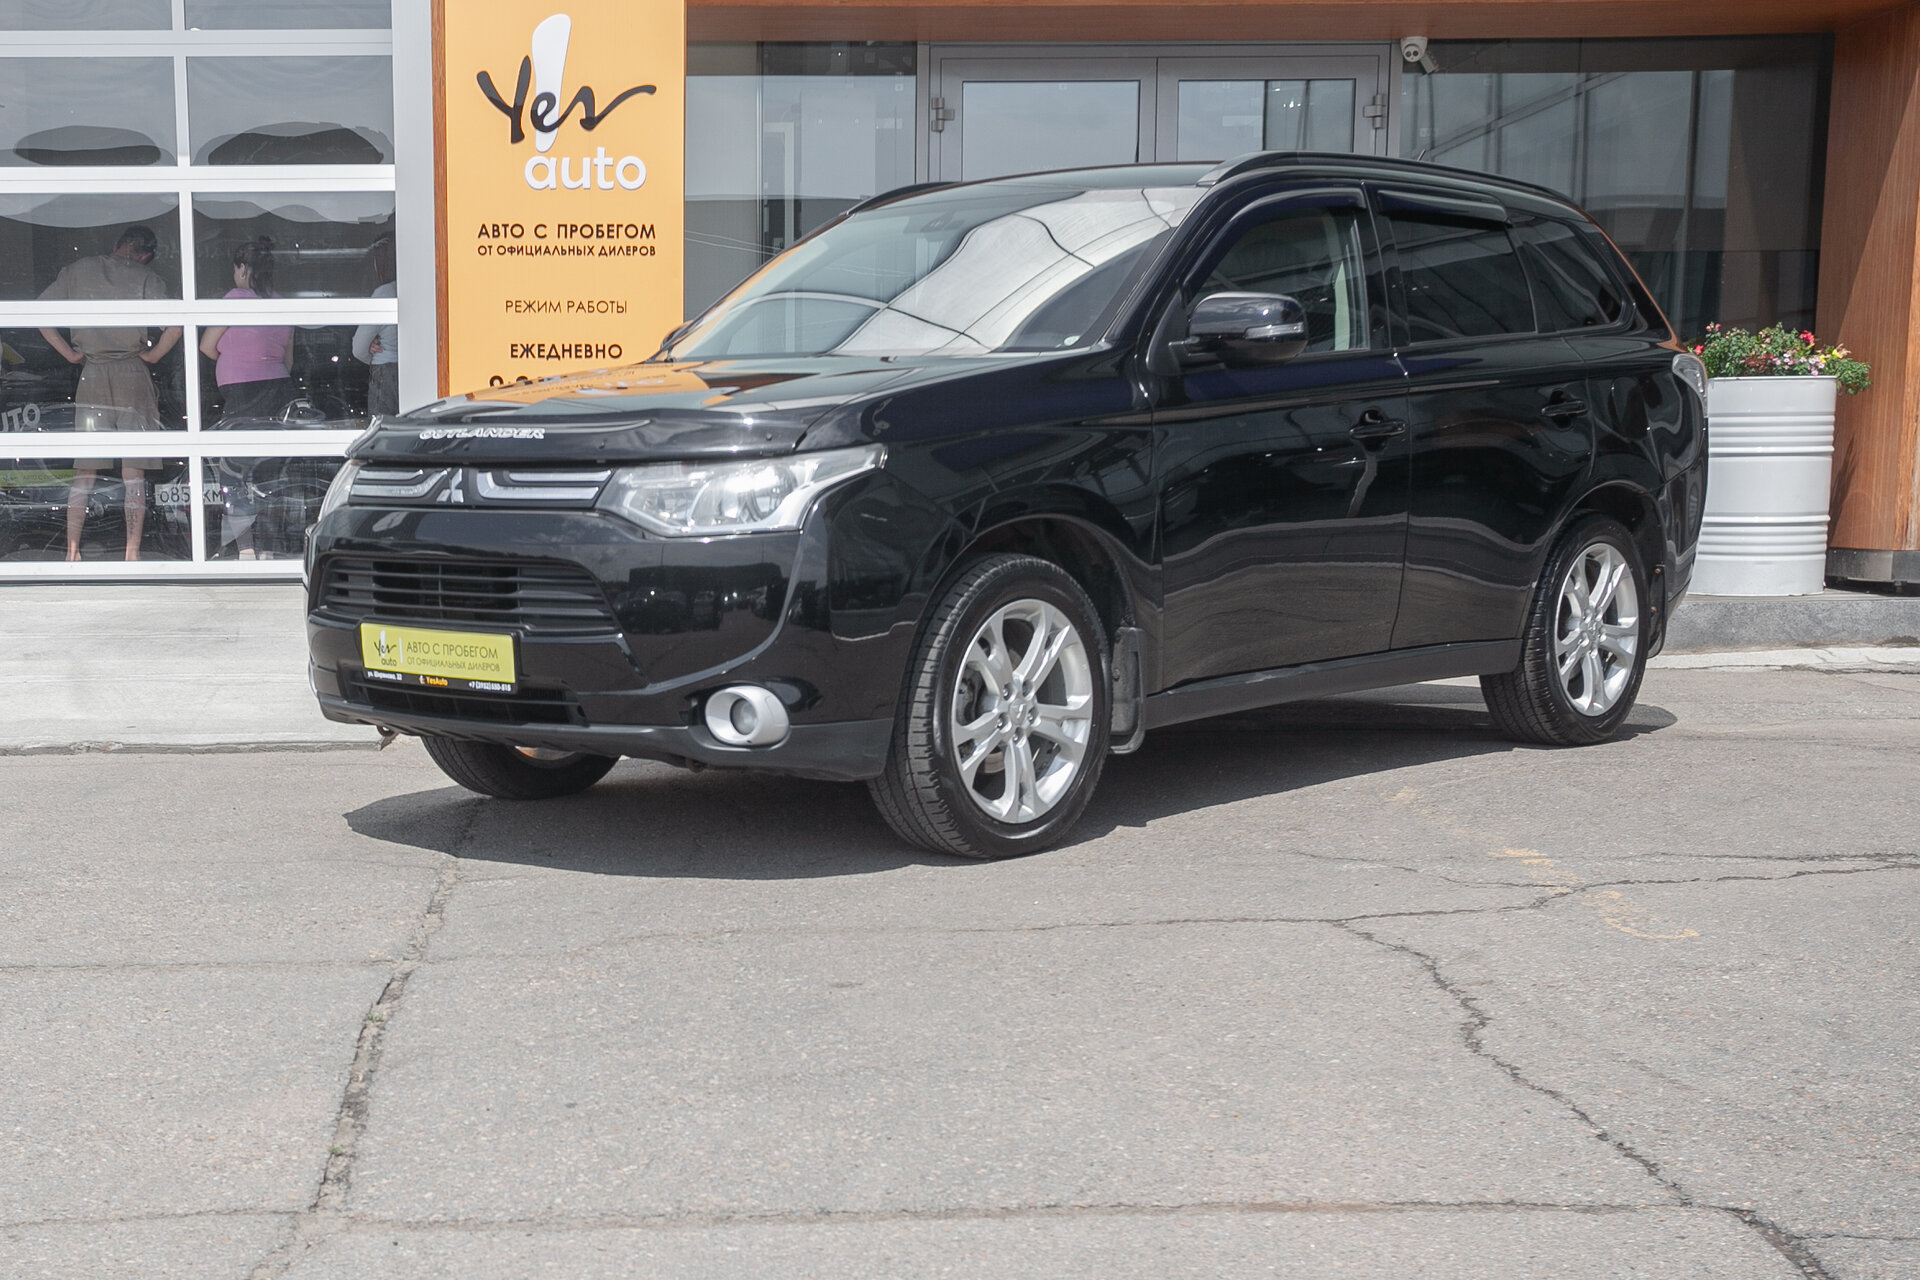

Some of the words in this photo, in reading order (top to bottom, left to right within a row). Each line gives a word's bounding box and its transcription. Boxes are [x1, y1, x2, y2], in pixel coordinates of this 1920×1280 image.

[524, 146, 647, 191] auto
[477, 223, 525, 239] АВТО
[534, 223, 548, 239] С
[557, 223, 656, 239] ПРОБЕГОМ
[477, 245, 493, 256] ОТ
[497, 244, 595, 257] ОФИЦИАЛЬНЫХ
[598, 245, 656, 257] ДИЛЕРОВ
[505, 300, 562, 314] РЕЖИМ
[567, 300, 628, 314] РАБОТЫ
[510, 343, 623, 361] ЕЖЕДНЕВНО
[419, 427, 546, 440] OUTLANDER
[406, 641, 430, 654] АВТО
[432, 643, 440, 655] С
[442, 643, 498, 659] ПРОБЕГОМ
[381, 656, 397, 666] auto
[416, 657, 466, 669] ОФИЦИАЛЬНЫХ
[467, 662, 500, 672] ДИЛЕРОВ
